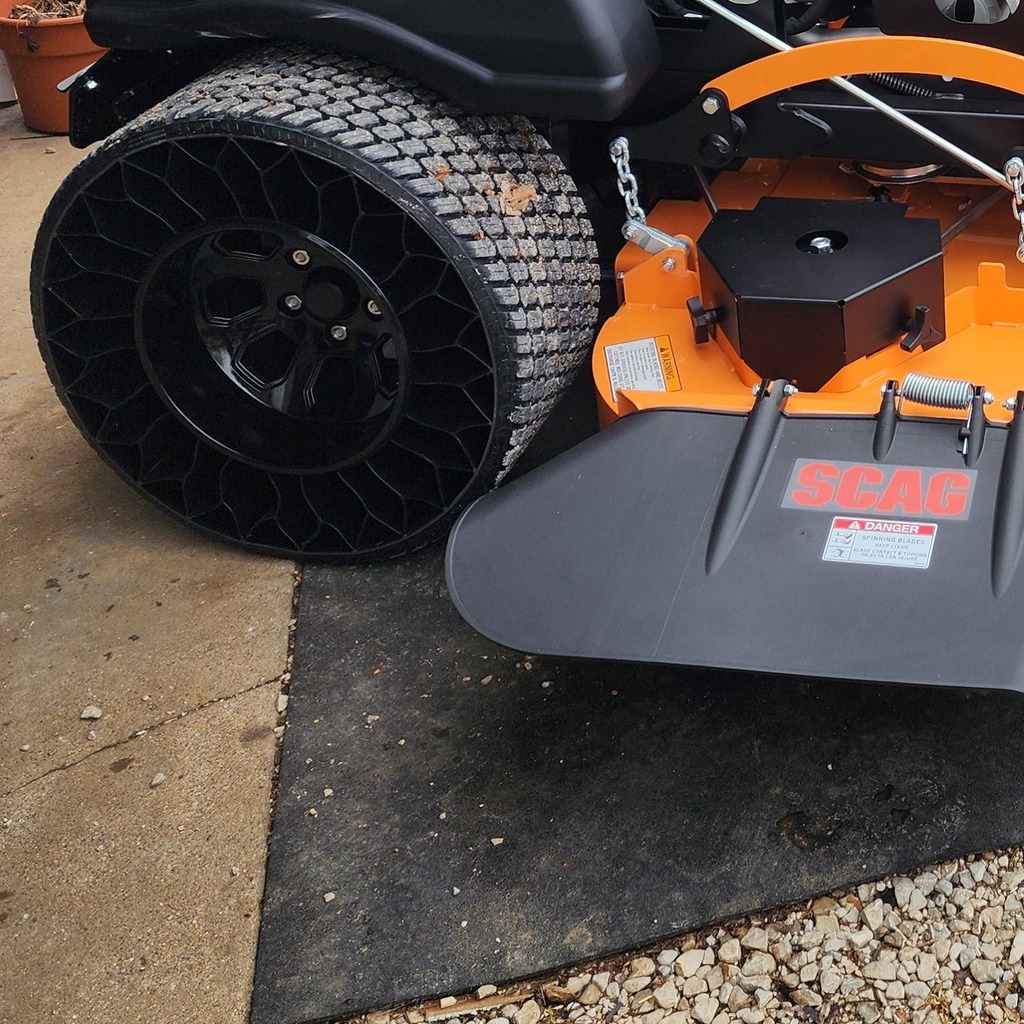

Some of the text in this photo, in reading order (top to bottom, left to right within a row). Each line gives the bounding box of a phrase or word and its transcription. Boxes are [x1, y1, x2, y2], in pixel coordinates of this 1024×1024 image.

[662, 354, 674, 380] WARNING
[790, 462, 972, 516] SCAG
[864, 522, 920, 534] DANGER
